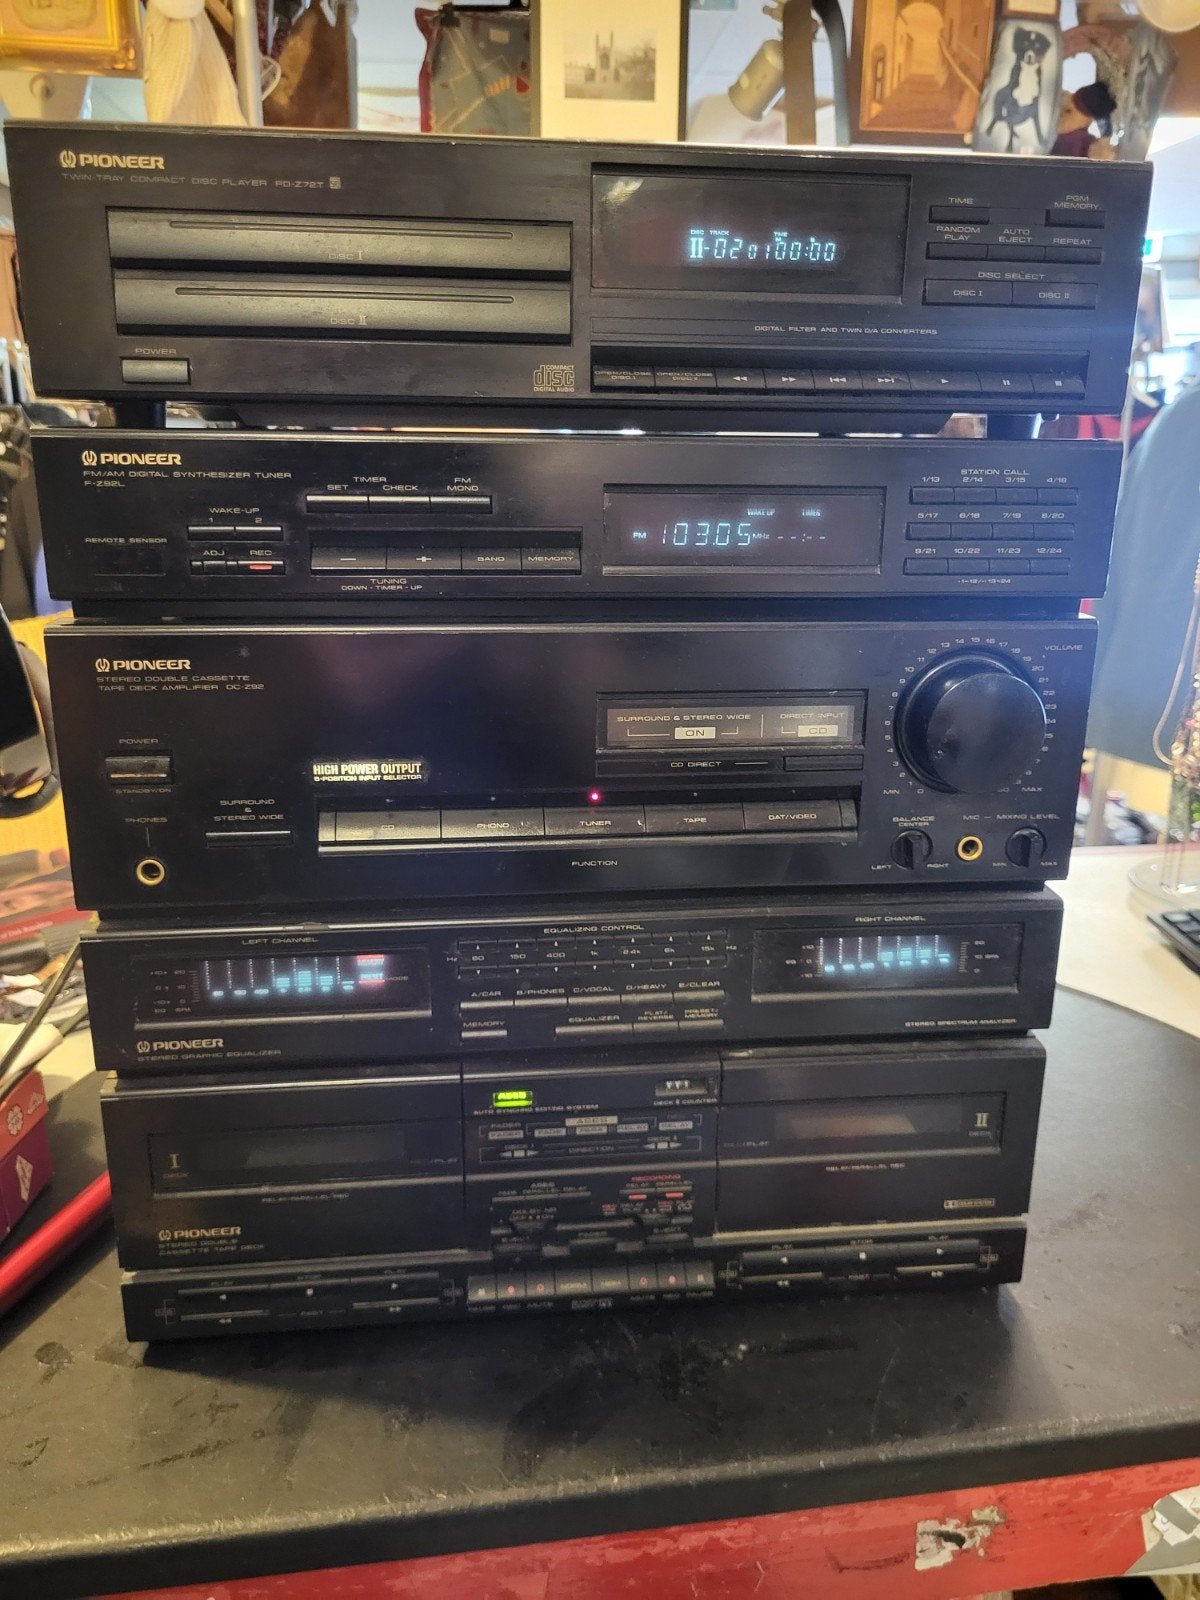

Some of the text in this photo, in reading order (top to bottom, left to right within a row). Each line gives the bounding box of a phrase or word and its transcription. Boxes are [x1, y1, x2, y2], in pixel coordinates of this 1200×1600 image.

[79, 153, 165, 169] PIONEER
[222, 178, 268, 186] PLAYER
[1054, 202, 1099, 210] MEMORY
[774, 241, 836, 262] 00:00
[328, 252, 354, 260] DISC
[953, 289, 978, 297] DISC
[330, 317, 354, 326] DISC
[135, 347, 177, 355] POWER
[100, 453, 182, 466] PIONEER
[112, 659, 192, 671] PIONEER
[685, 729, 705, 737] ON
[312, 763, 422, 776] HIGH POWER OUTPUT
[516, 988, 566, 996] B/PHONES
[568, 1015, 620, 1023] EQUALIZER
[152, 1038, 224, 1051] PIONEER
[174, 1226, 241, 1238] PIONEER
